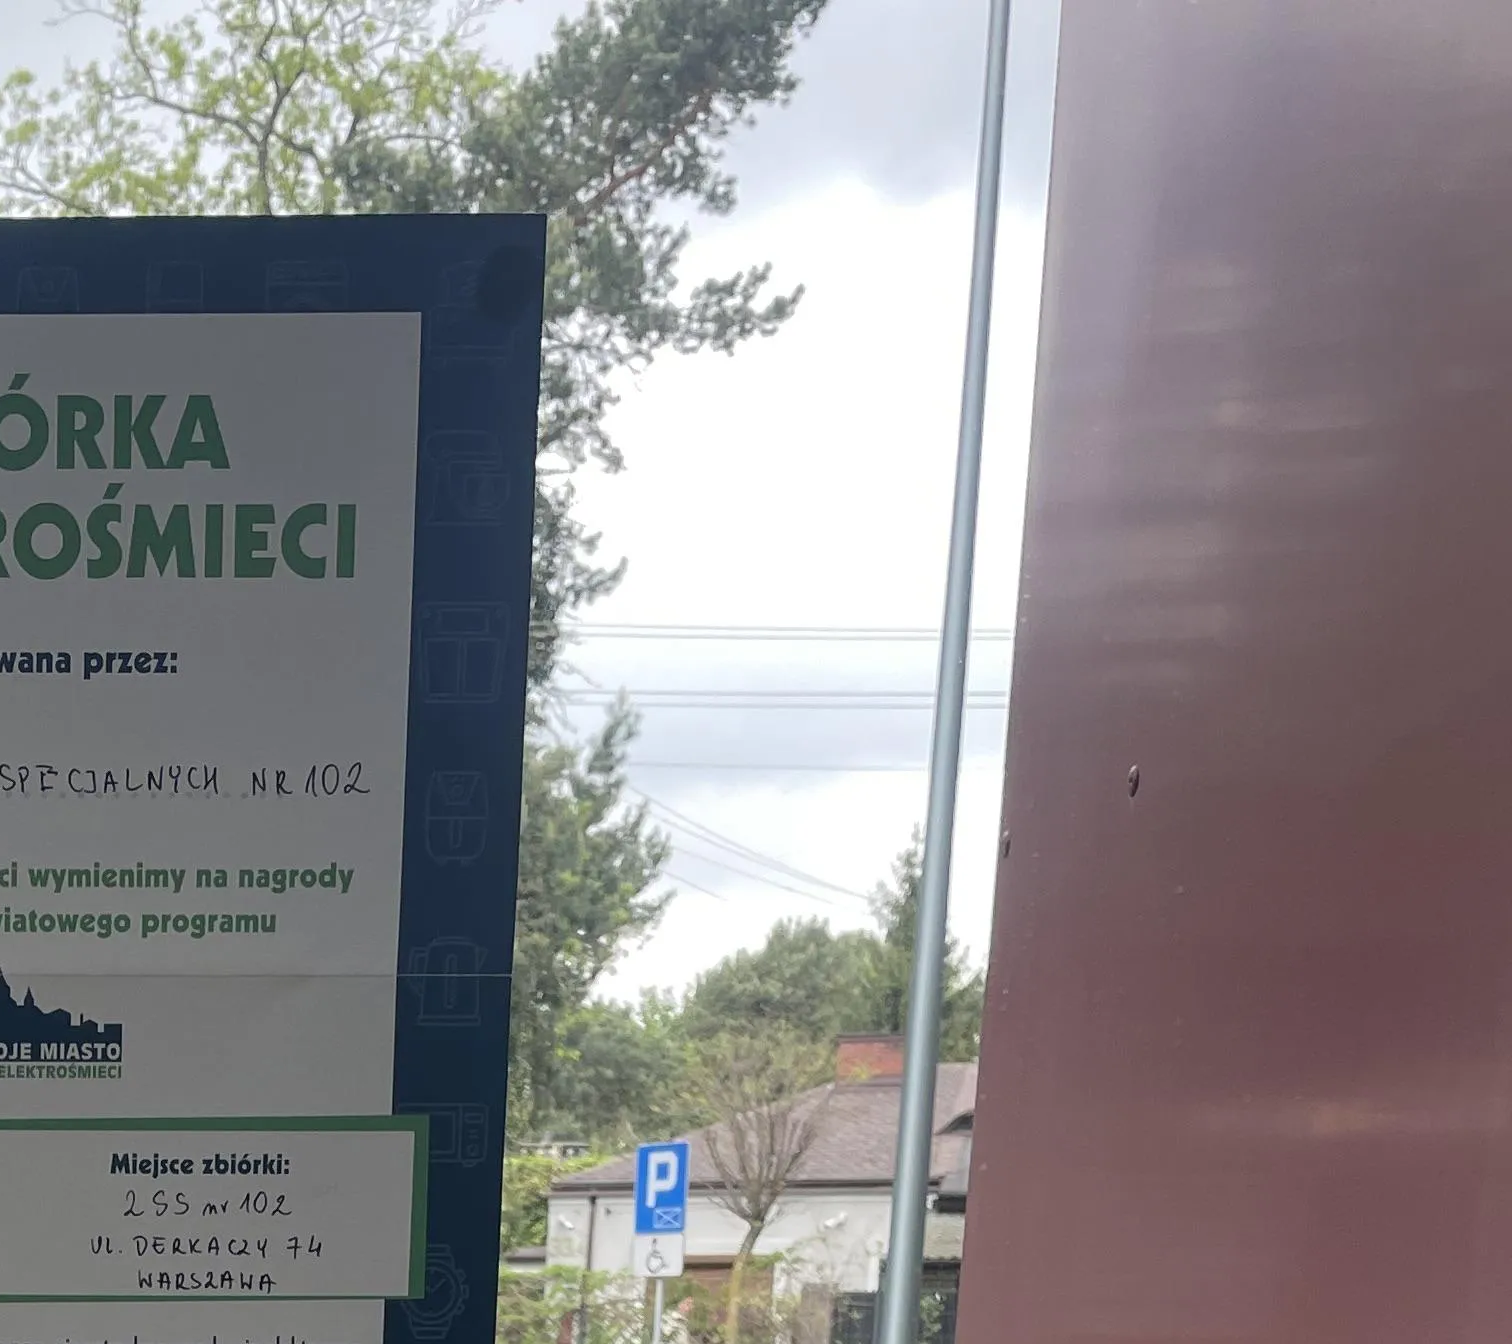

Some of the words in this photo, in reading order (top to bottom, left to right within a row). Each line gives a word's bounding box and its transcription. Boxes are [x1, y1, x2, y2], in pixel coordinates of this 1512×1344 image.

[83, 651, 178, 681] przez:
[251, 767, 293, 796] NR
[305, 762, 370, 797] 102
[27, 861, 187, 894] wymienimy
[195, 868, 228, 889] na
[238, 861, 355, 895] nagrody
[141, 913, 277, 939] programu
[40, 1042, 122, 1061] MIASTO
[109, 1152, 195, 1180] Miejsce
[201, 1153, 290, 1176] zbiórki:
[646, 1150, 679, 1207] P
[239, 1191, 292, 1217] 102
[133, 1235, 268, 1258] DERKACZY
[286, 1236, 322, 1260] 74
[138, 1270, 277, 1294] WARSZAWA
